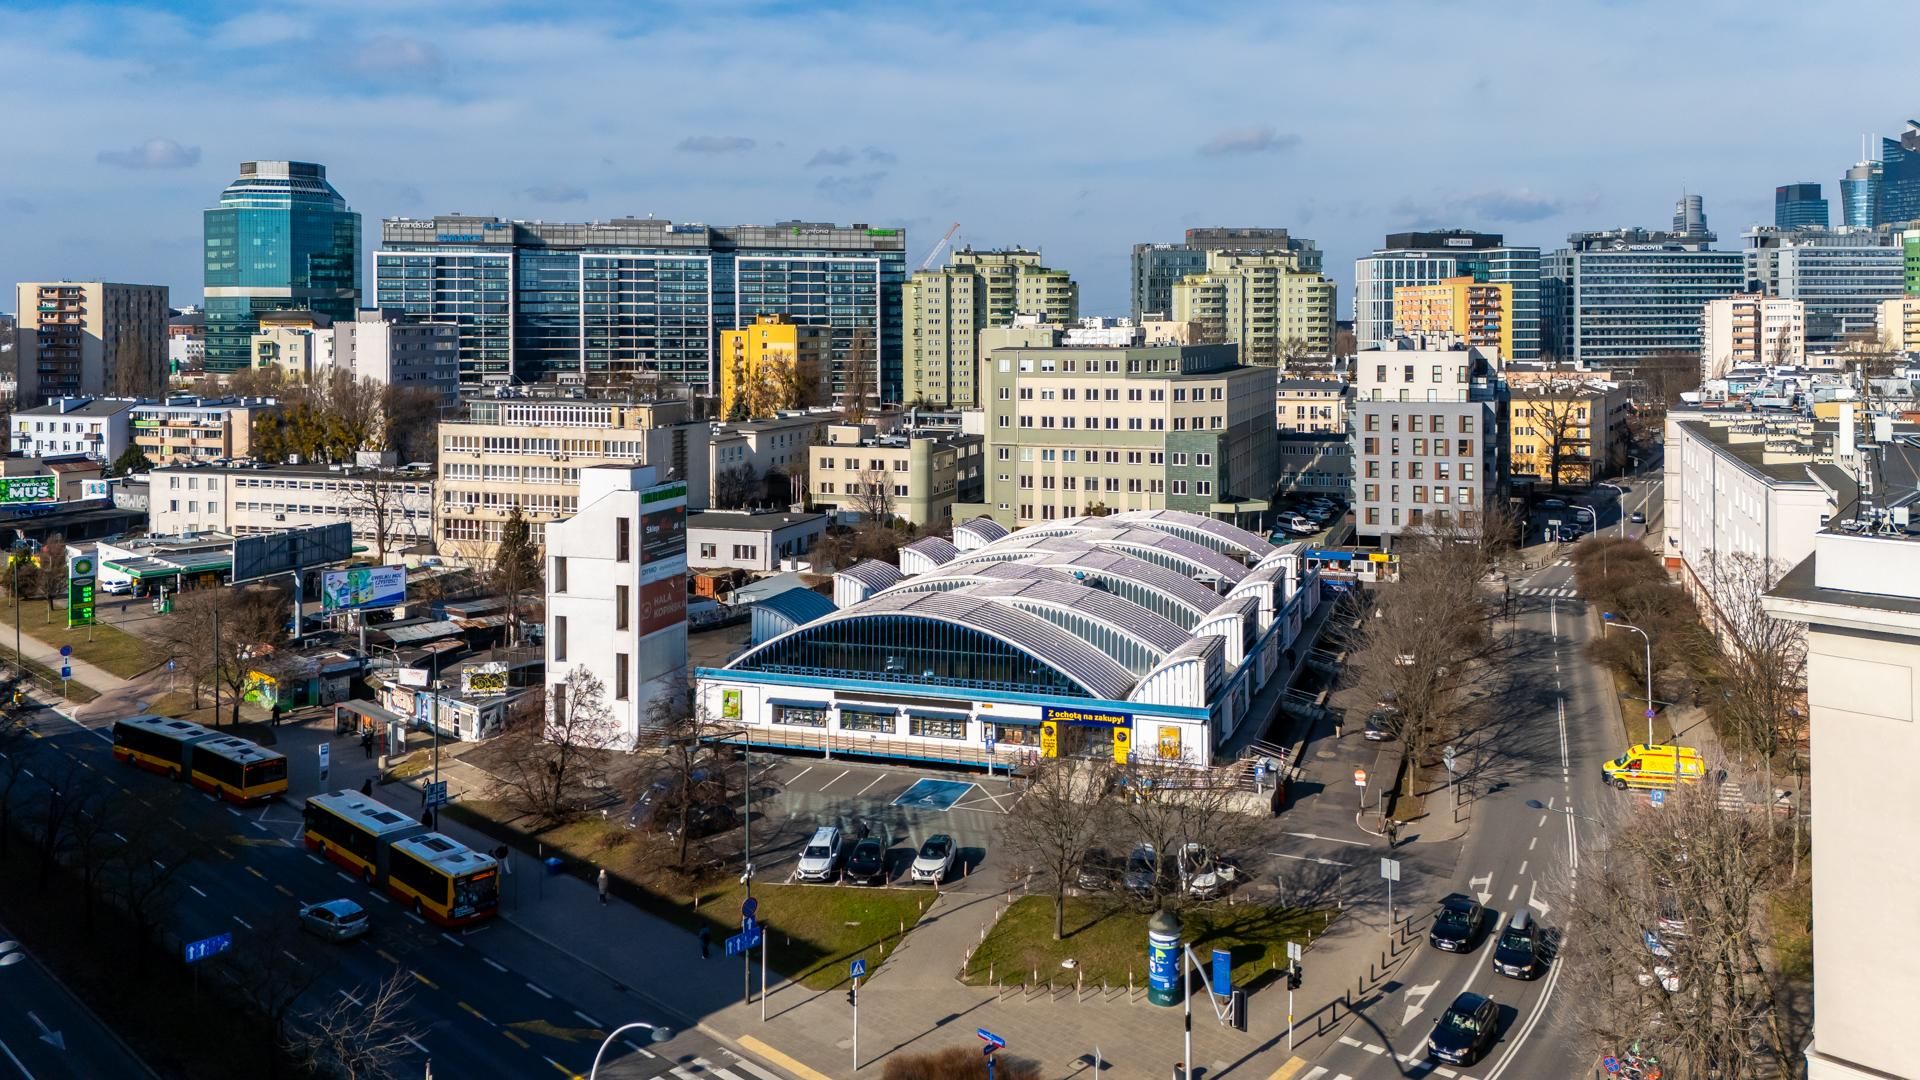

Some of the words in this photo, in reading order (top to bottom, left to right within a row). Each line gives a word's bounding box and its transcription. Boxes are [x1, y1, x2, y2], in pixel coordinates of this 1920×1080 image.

[400, 221, 434, 229] randstad
[10, 487, 49, 498] MUS
[654, 592, 672, 607] HALA
[1055, 711, 1082, 721] ochotą
[1094, 714, 1125, 724] zakupy!
